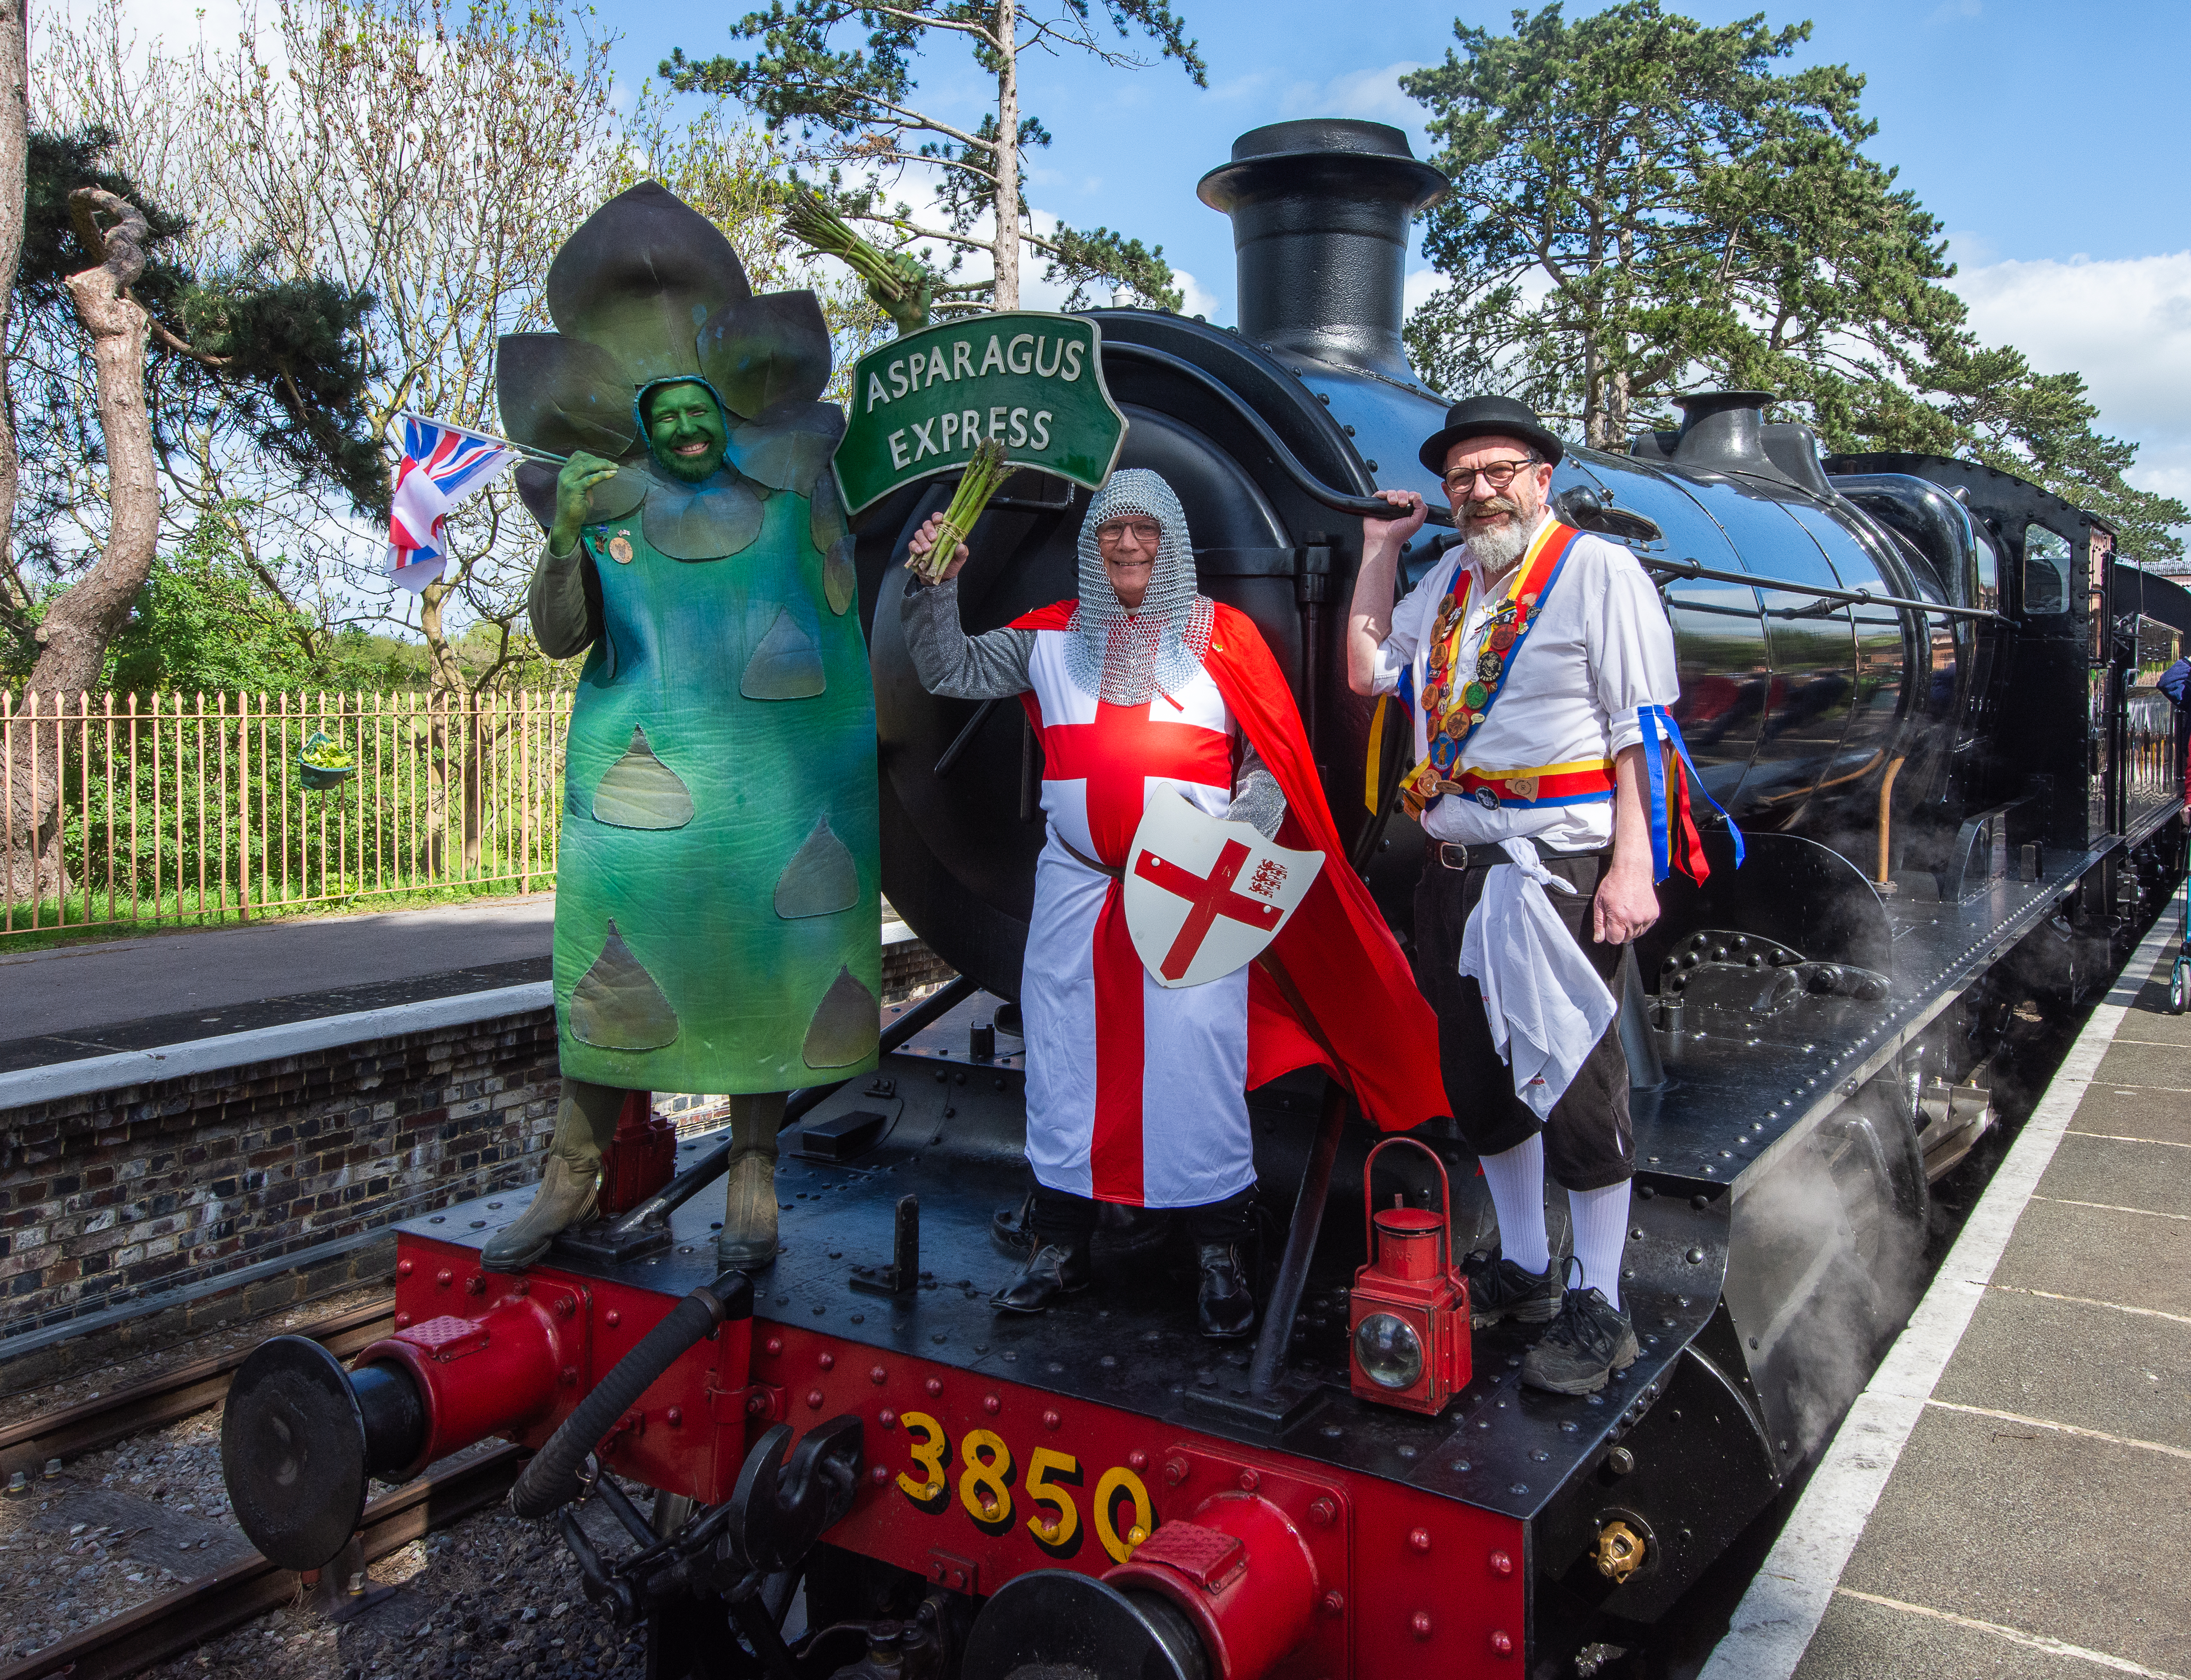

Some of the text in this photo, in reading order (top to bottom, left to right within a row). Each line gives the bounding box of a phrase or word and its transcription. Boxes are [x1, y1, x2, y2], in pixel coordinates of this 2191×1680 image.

[867, 334, 1086, 414] ASPARAGUS
[888, 406, 1053, 471] EXPRESS
[897, 1411, 1153, 1564] 3850
